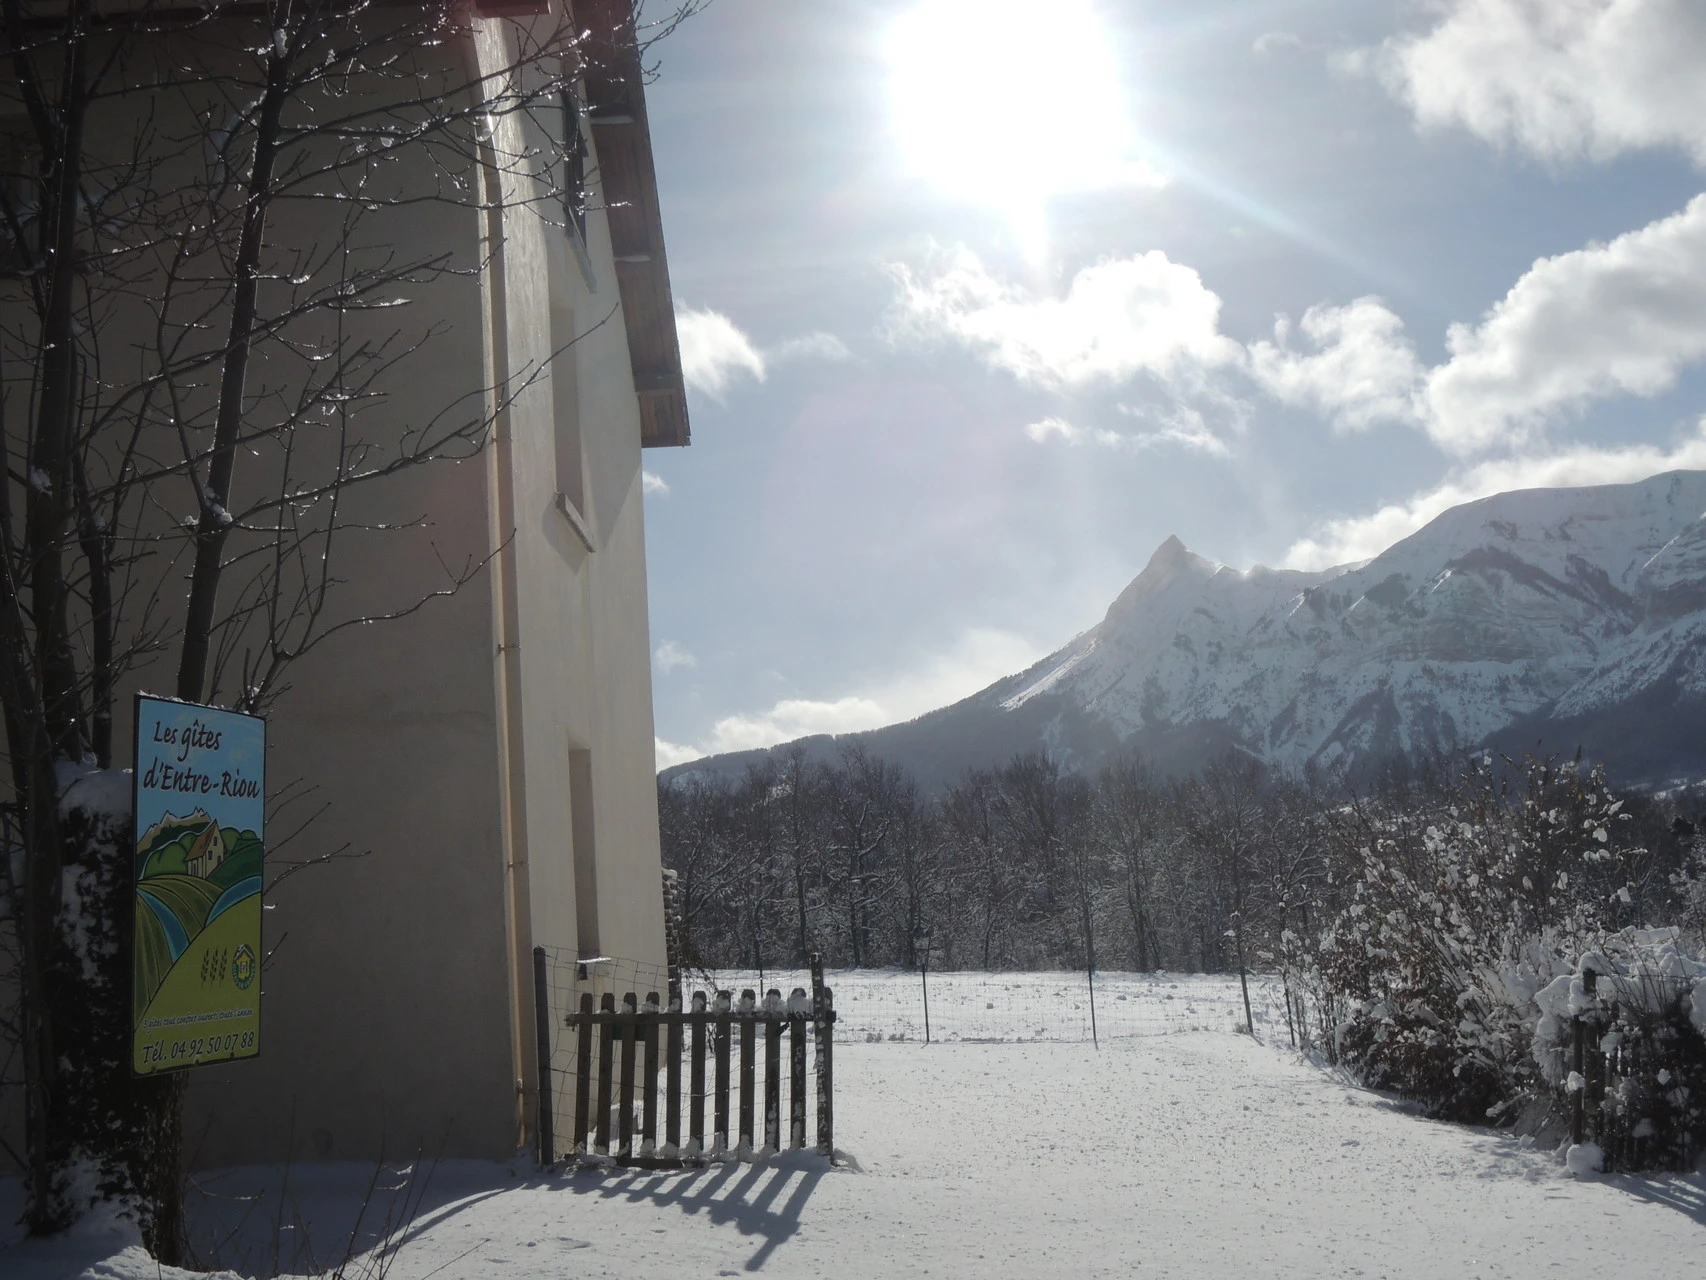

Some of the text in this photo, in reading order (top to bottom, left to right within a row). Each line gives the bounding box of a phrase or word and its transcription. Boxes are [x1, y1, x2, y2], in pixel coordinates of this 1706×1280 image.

[153, 718, 222, 762] Les gîtes
[143, 756, 260, 798] d'Entre-Riou
[143, 1031, 255, 1064] Tél. 04 92 50 07 88
